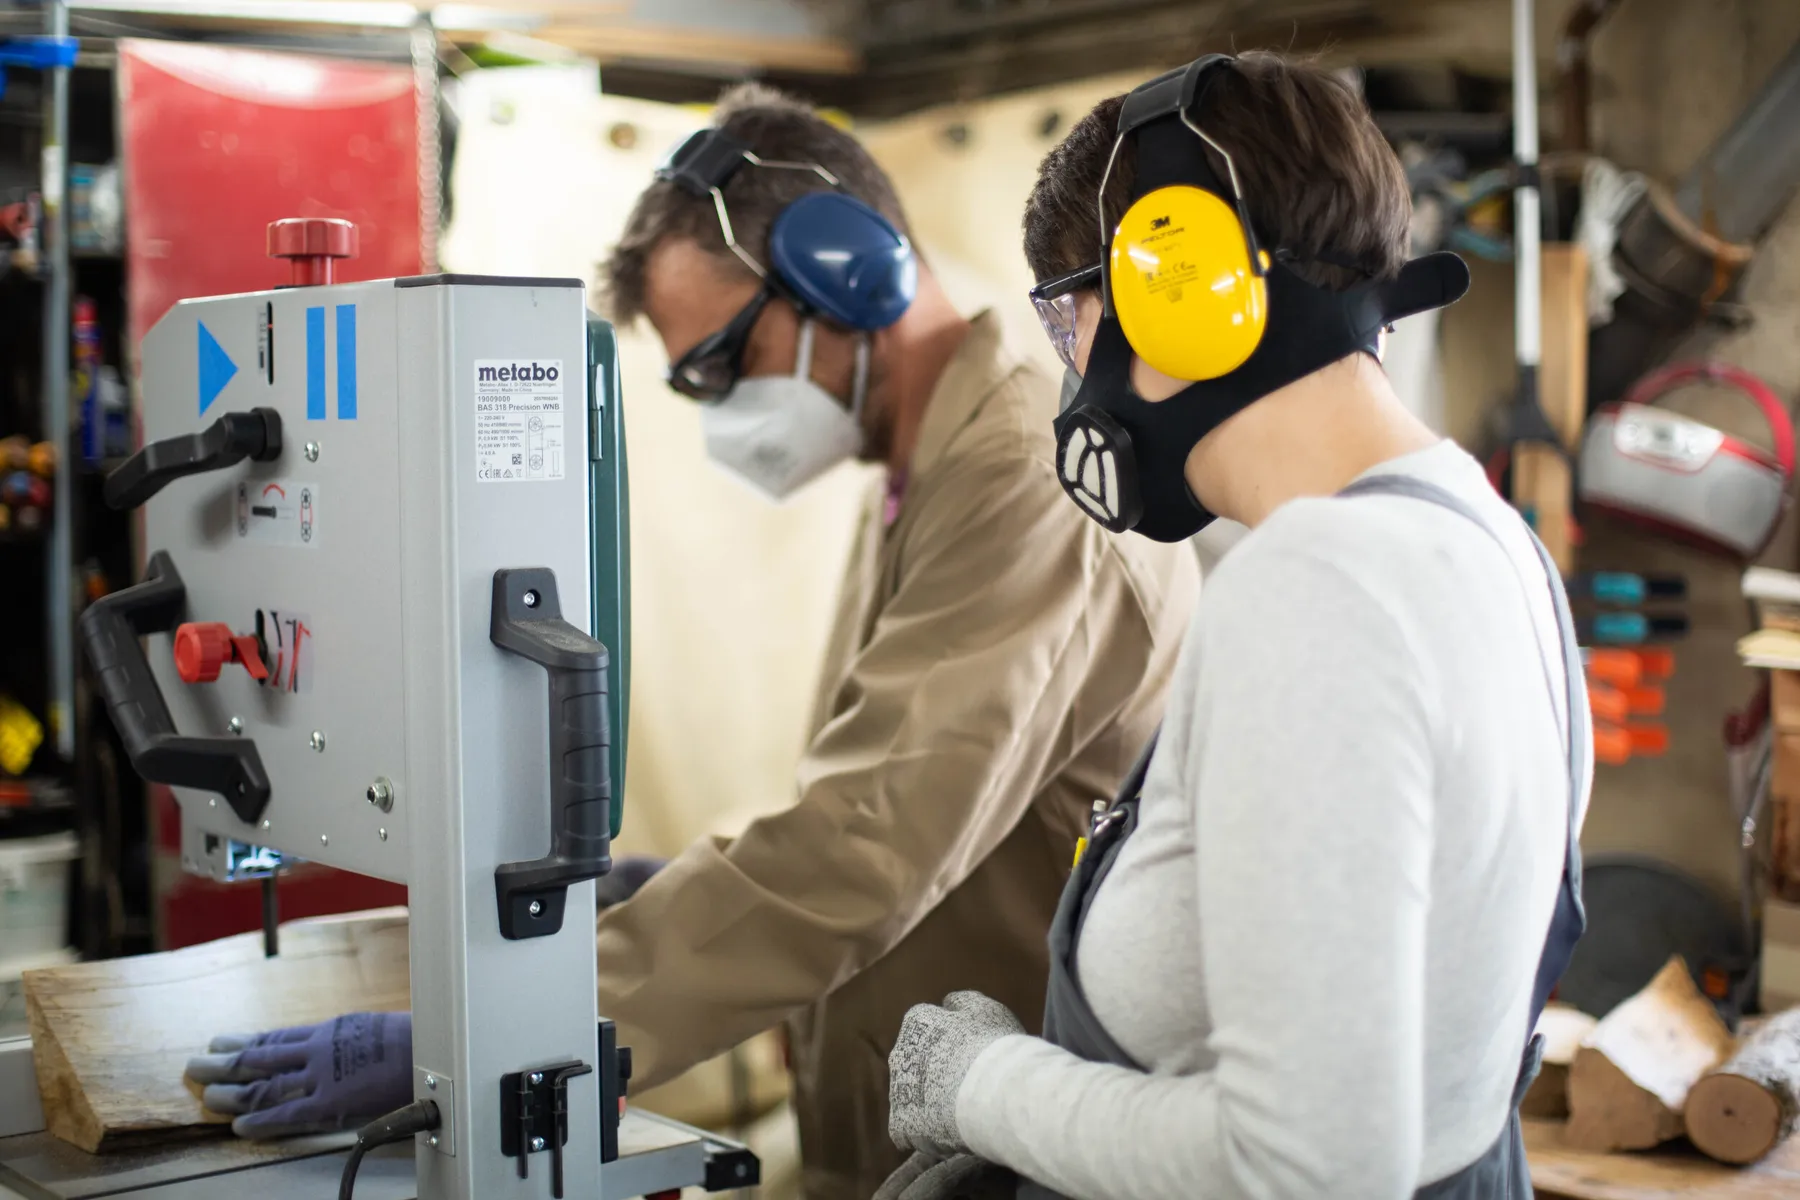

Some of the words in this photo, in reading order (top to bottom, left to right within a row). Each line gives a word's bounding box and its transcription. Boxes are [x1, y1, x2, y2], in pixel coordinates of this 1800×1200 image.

[1151, 215, 1171, 231] 3M
[478, 362, 559, 382] metabo
[509, 403, 541, 411] Precision
